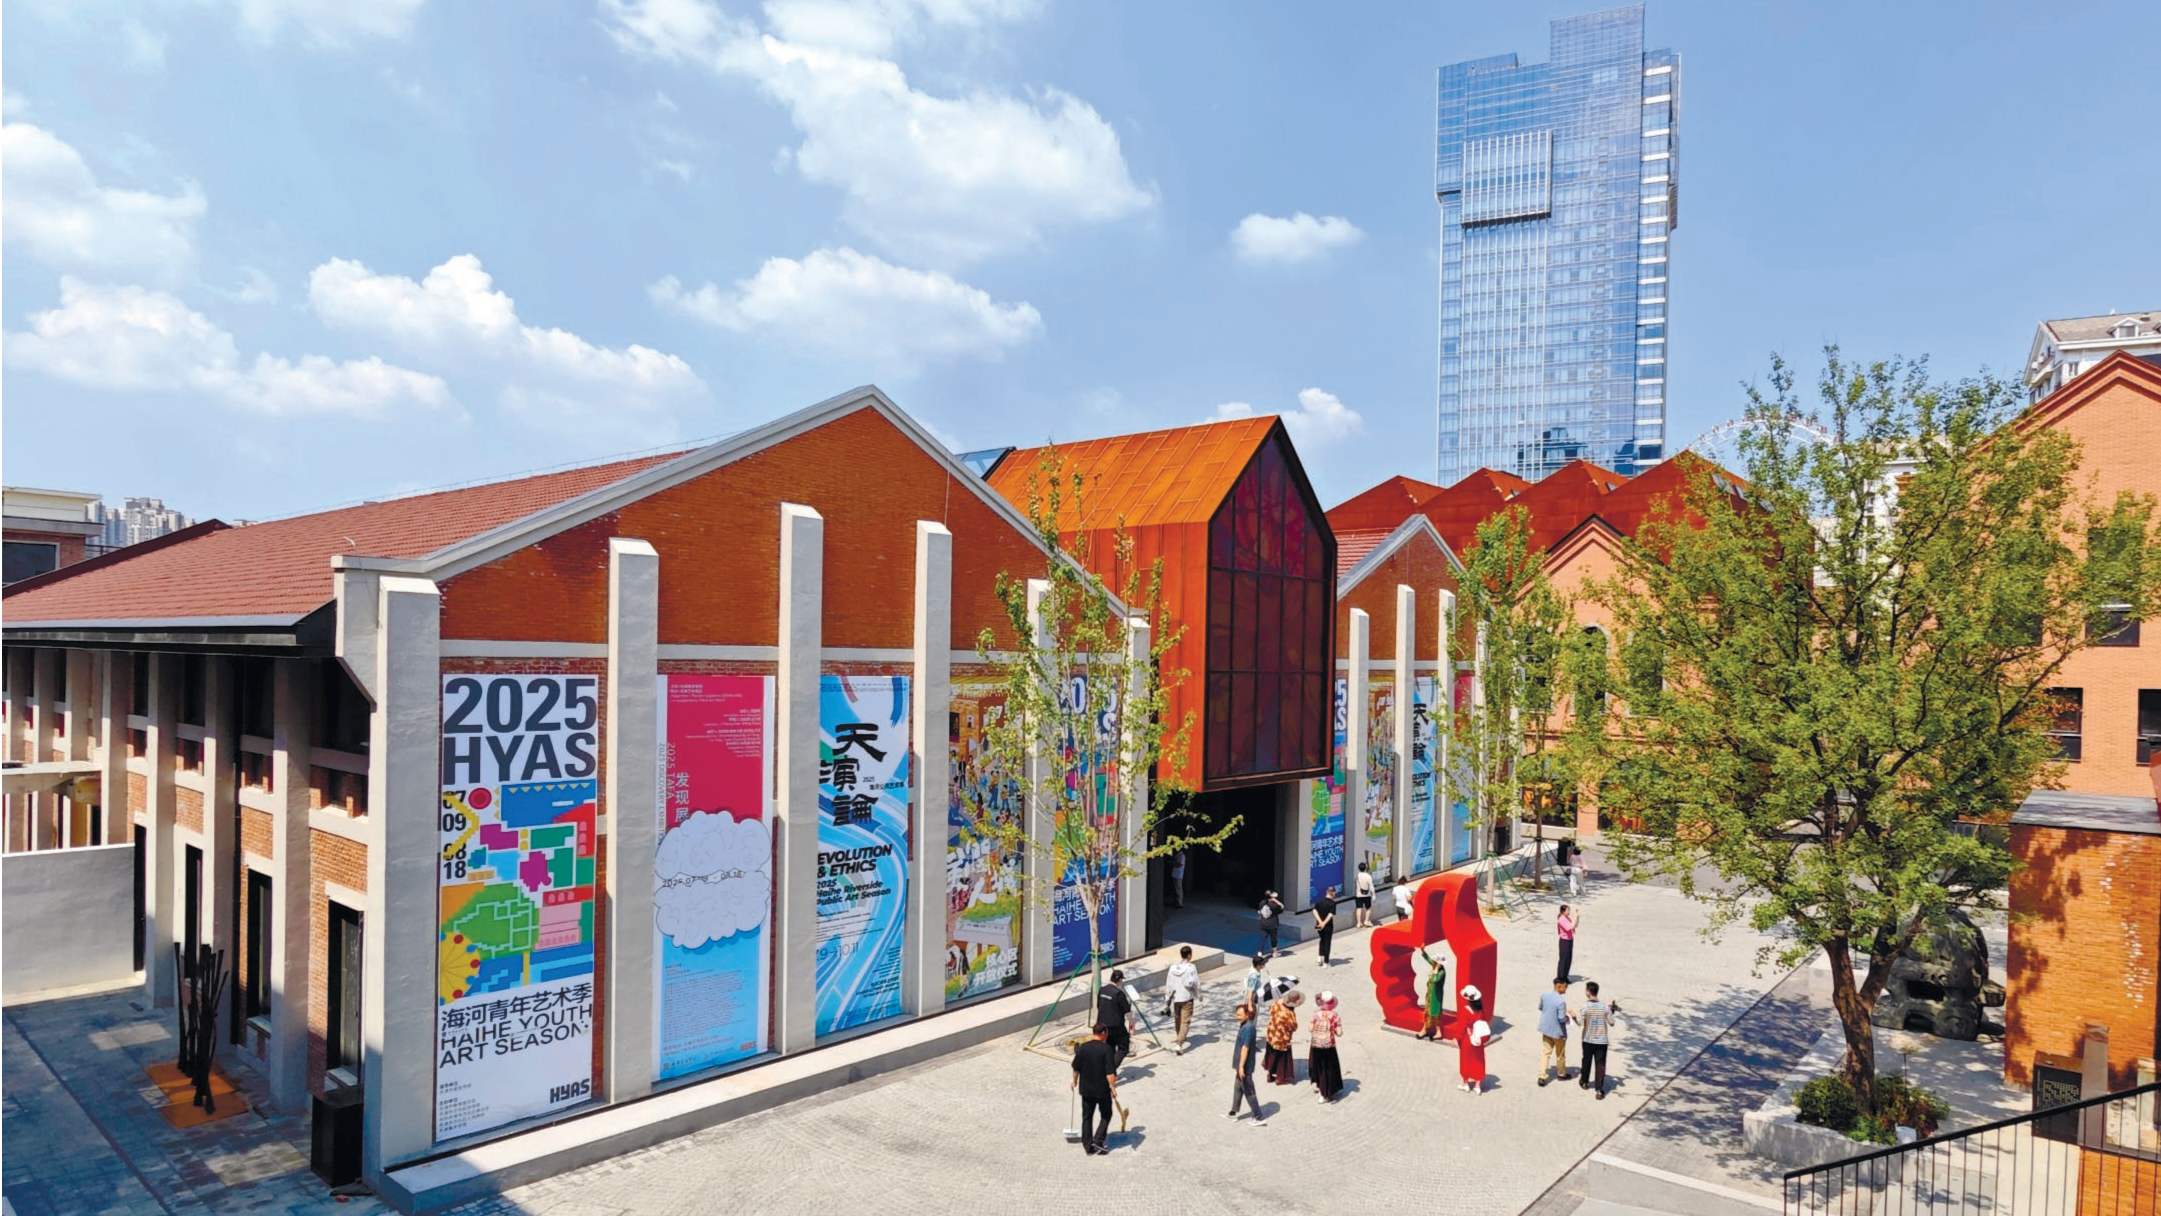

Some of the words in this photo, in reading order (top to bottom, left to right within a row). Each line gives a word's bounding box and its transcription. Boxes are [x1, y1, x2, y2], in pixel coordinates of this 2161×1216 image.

[443, 677, 597, 735] 2025
[443, 731, 597, 785] HYAS
[665, 742, 676, 769] 2025
[666, 773, 676, 800] TAFA
[675, 772, 690, 823] 发现展
[442, 813, 467, 832] 09
[818, 844, 893, 866] EVOLUTION
[443, 860, 467, 880] 18
[817, 866, 827, 879] &
[829, 859, 877, 877] ETHICS
[816, 879, 837, 890] 2025
[844, 881, 883, 894] Riverside
[845, 893, 860, 902] Art
[861, 888, 891, 900] Season
[441, 982, 593, 1031] 海河青年艺术季
[441, 1020, 512, 1051] HAIHE
[518, 1003, 593, 1029] YOUTH
[440, 1042, 489, 1069] ART
[550, 1078, 591, 1104] HYAS
